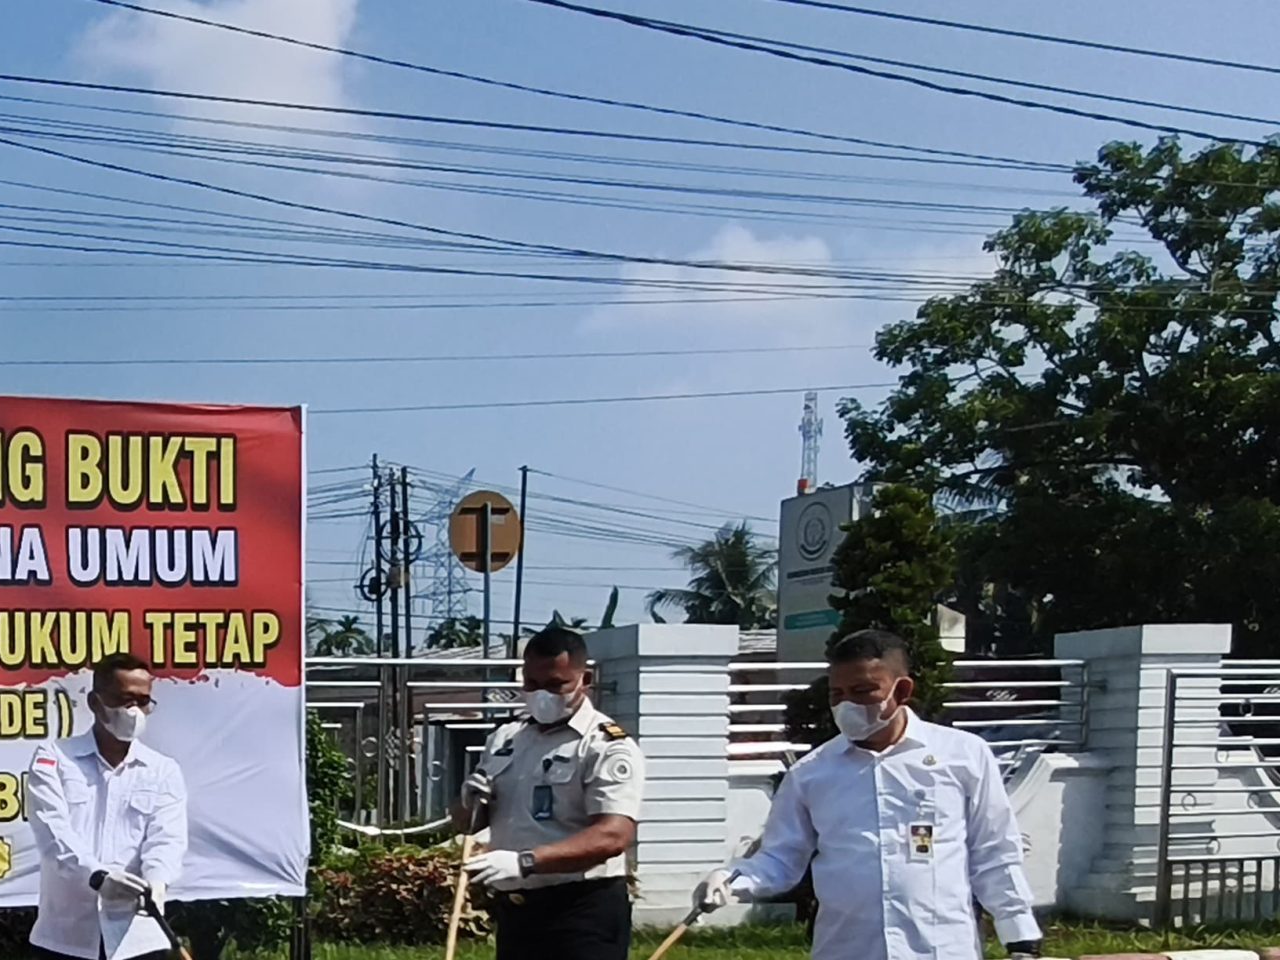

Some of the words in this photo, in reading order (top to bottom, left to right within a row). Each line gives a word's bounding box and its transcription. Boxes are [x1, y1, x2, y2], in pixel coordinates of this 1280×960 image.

[67, 432, 236, 507] BUKTI
[67, 526, 237, 584] UMUM
[144, 611, 280, 665] TETAP
